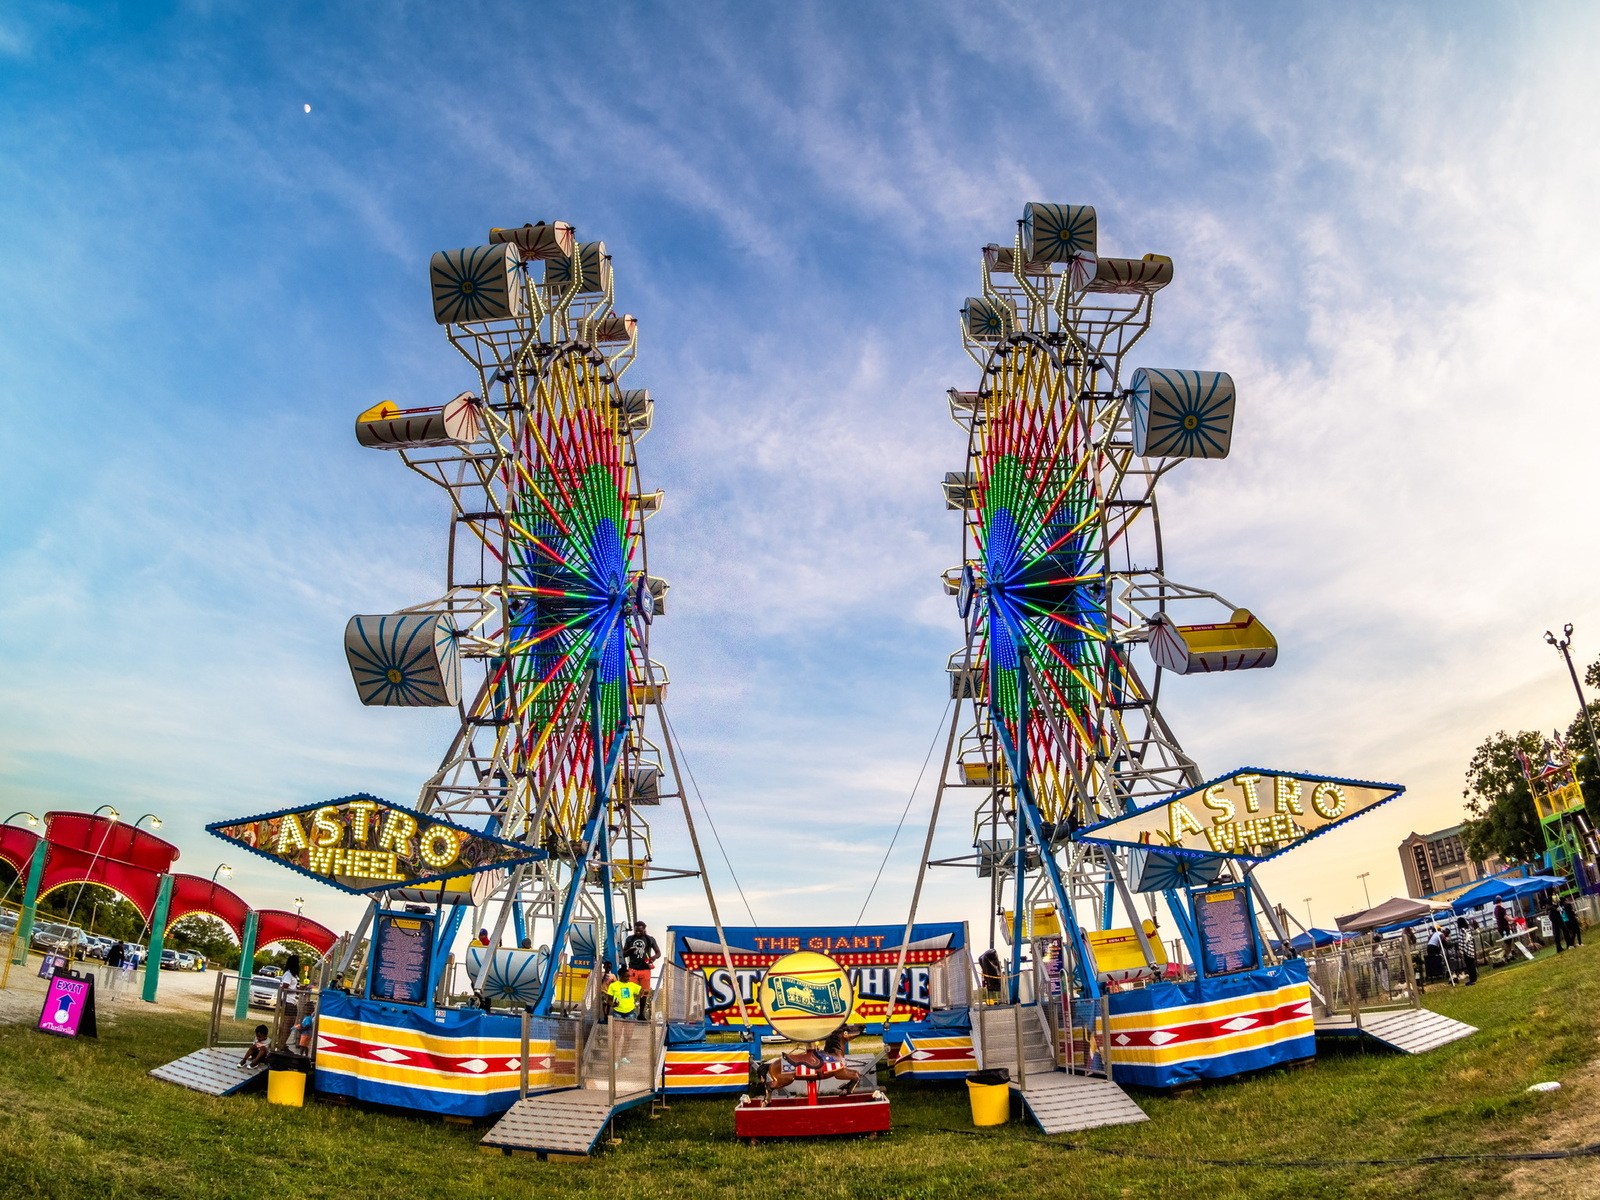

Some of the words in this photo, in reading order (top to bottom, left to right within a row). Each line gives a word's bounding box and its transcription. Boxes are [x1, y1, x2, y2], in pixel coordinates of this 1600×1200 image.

[1187, 418, 1194, 426] 5
[1168, 773, 1346, 843] ASTRO
[276, 801, 460, 868] ASTRO
[1204, 814, 1305, 852] WHEEL
[308, 846, 405, 881] WHEEL
[753, 937, 800, 950] THE
[807, 935, 886, 950] GIANT
[574, 959, 591, 967] EXIT
[56, 979, 84, 995] EXIT
[42, 1021, 75, 1035] #Thrillville
